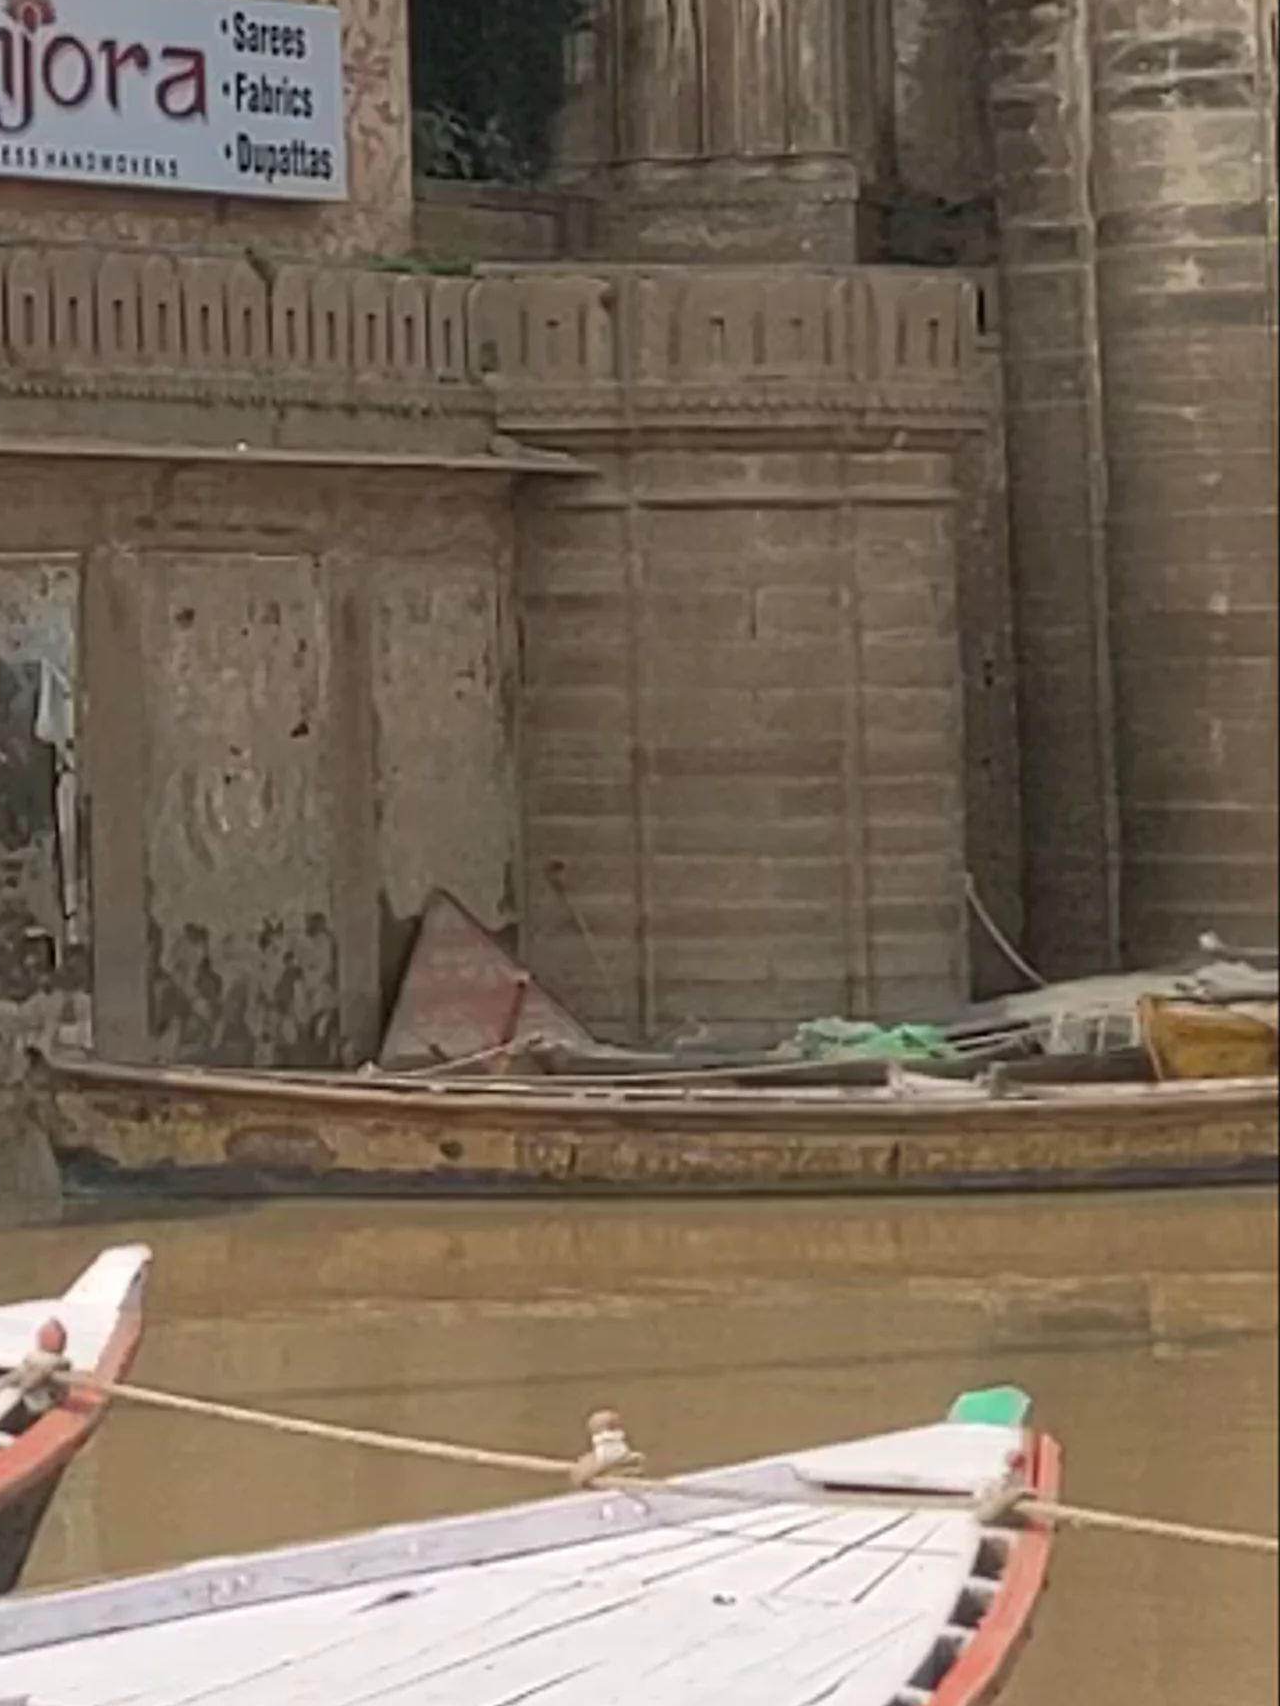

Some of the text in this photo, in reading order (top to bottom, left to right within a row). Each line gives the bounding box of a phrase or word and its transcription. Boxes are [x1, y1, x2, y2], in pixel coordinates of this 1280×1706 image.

[233, 12, 306, 60] Sarees
[236, 72, 313, 119] Fabrics
[237, 132, 333, 183] Dupattas
